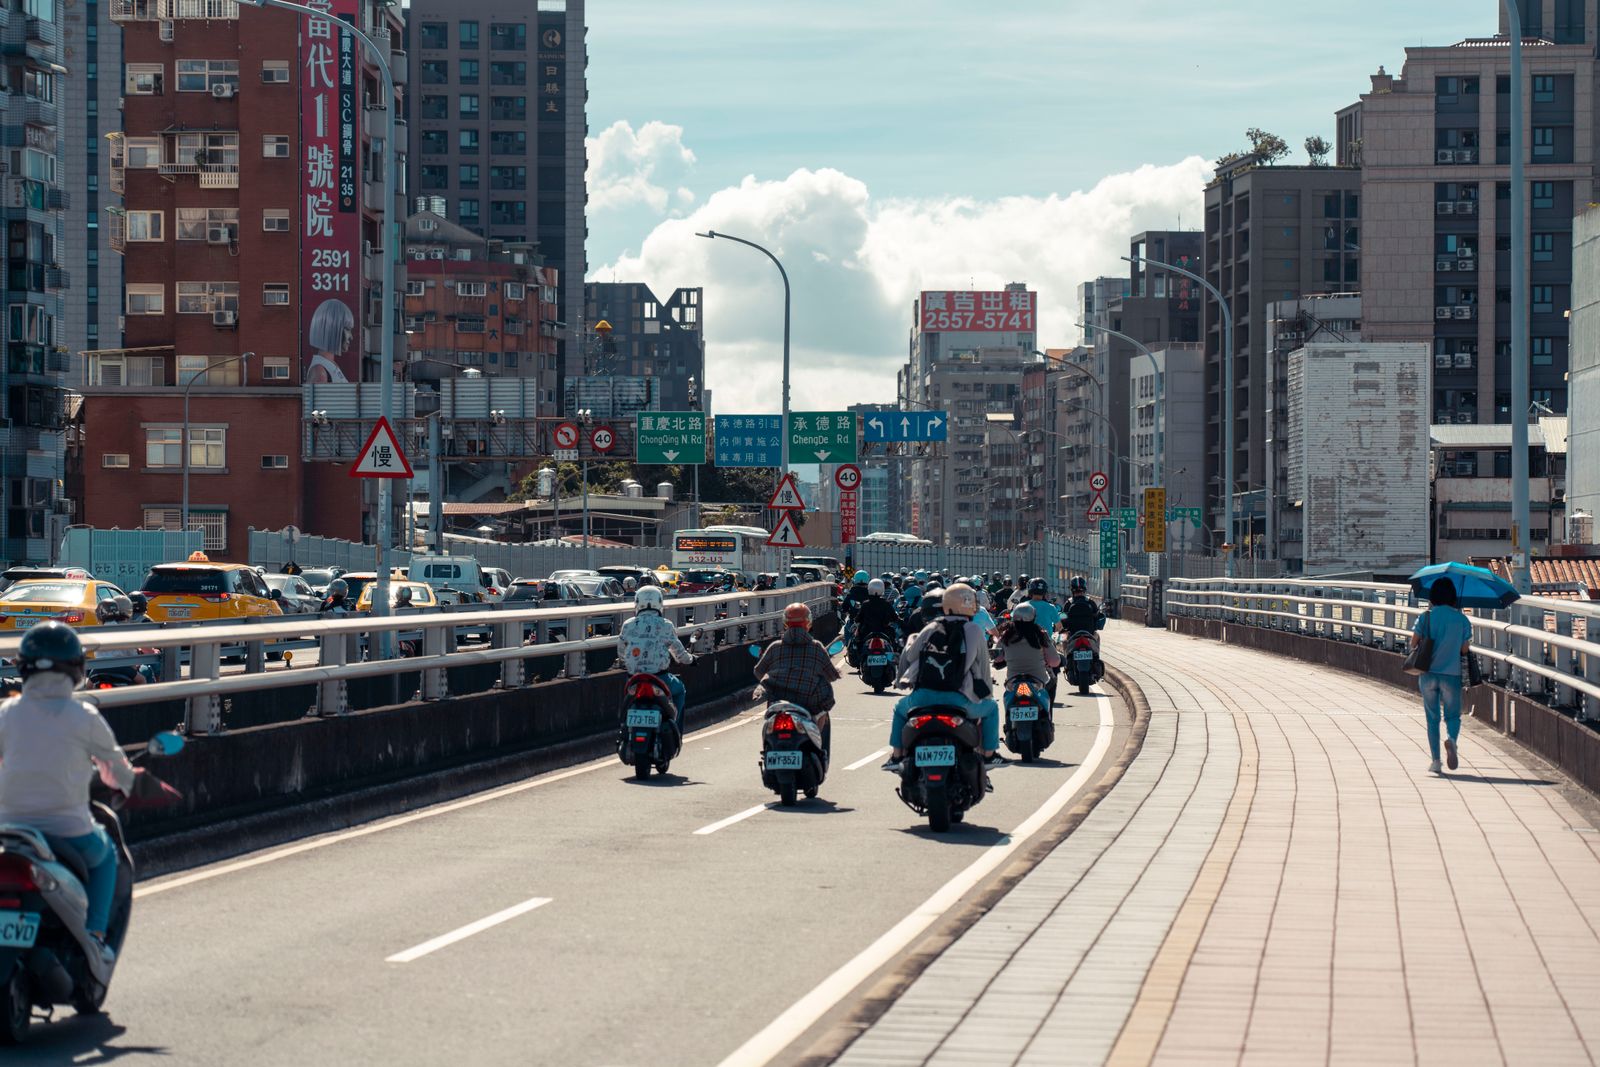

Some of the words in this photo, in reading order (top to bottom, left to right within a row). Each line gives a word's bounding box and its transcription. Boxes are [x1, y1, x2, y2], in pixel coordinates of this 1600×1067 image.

[311, 249, 350, 268] 2591
[311, 272, 349, 292] 3311
[925, 292, 1031, 310] 廣告出租
[925, 312, 1031, 328] 2557-5741
[640, 416, 703, 431] 重慶北路
[793, 415, 850, 431] 承德路
[595, 433, 611, 444] 40
[640, 434, 680, 446] ChongQing
[792, 434, 830, 446] ChengDe
[371, 445, 392, 468] 慢
[840, 472, 857, 482] 40
[1093, 478, 1105, 486] 40
[780, 490, 793, 504] 慢
[628, 715, 658, 725] 773-TBL
